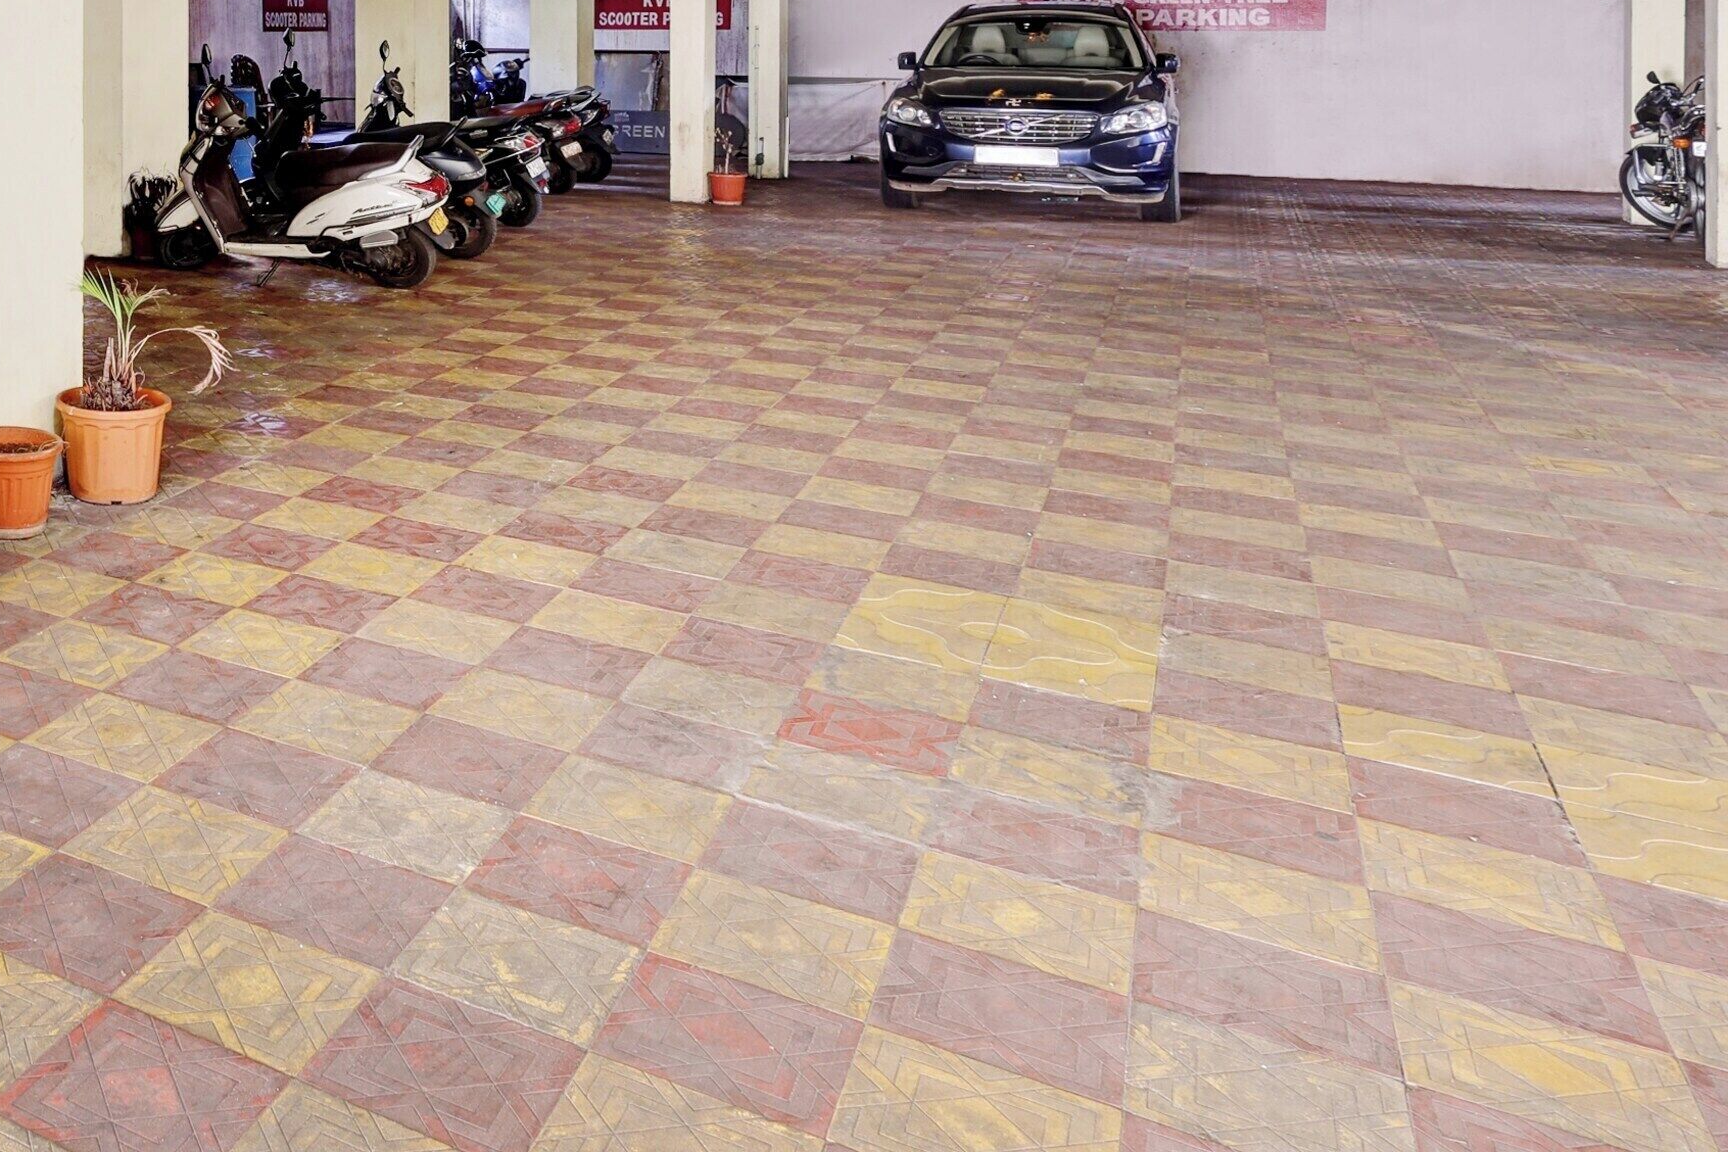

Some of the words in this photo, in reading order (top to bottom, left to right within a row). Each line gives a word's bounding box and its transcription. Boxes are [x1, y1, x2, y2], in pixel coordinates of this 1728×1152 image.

[265, 12, 298, 27] SCOOTER
[299, 12, 327, 27] PARKING
[599, 12, 658, 26] SCOOTER
[1136, 7, 1270, 26] PARKING
